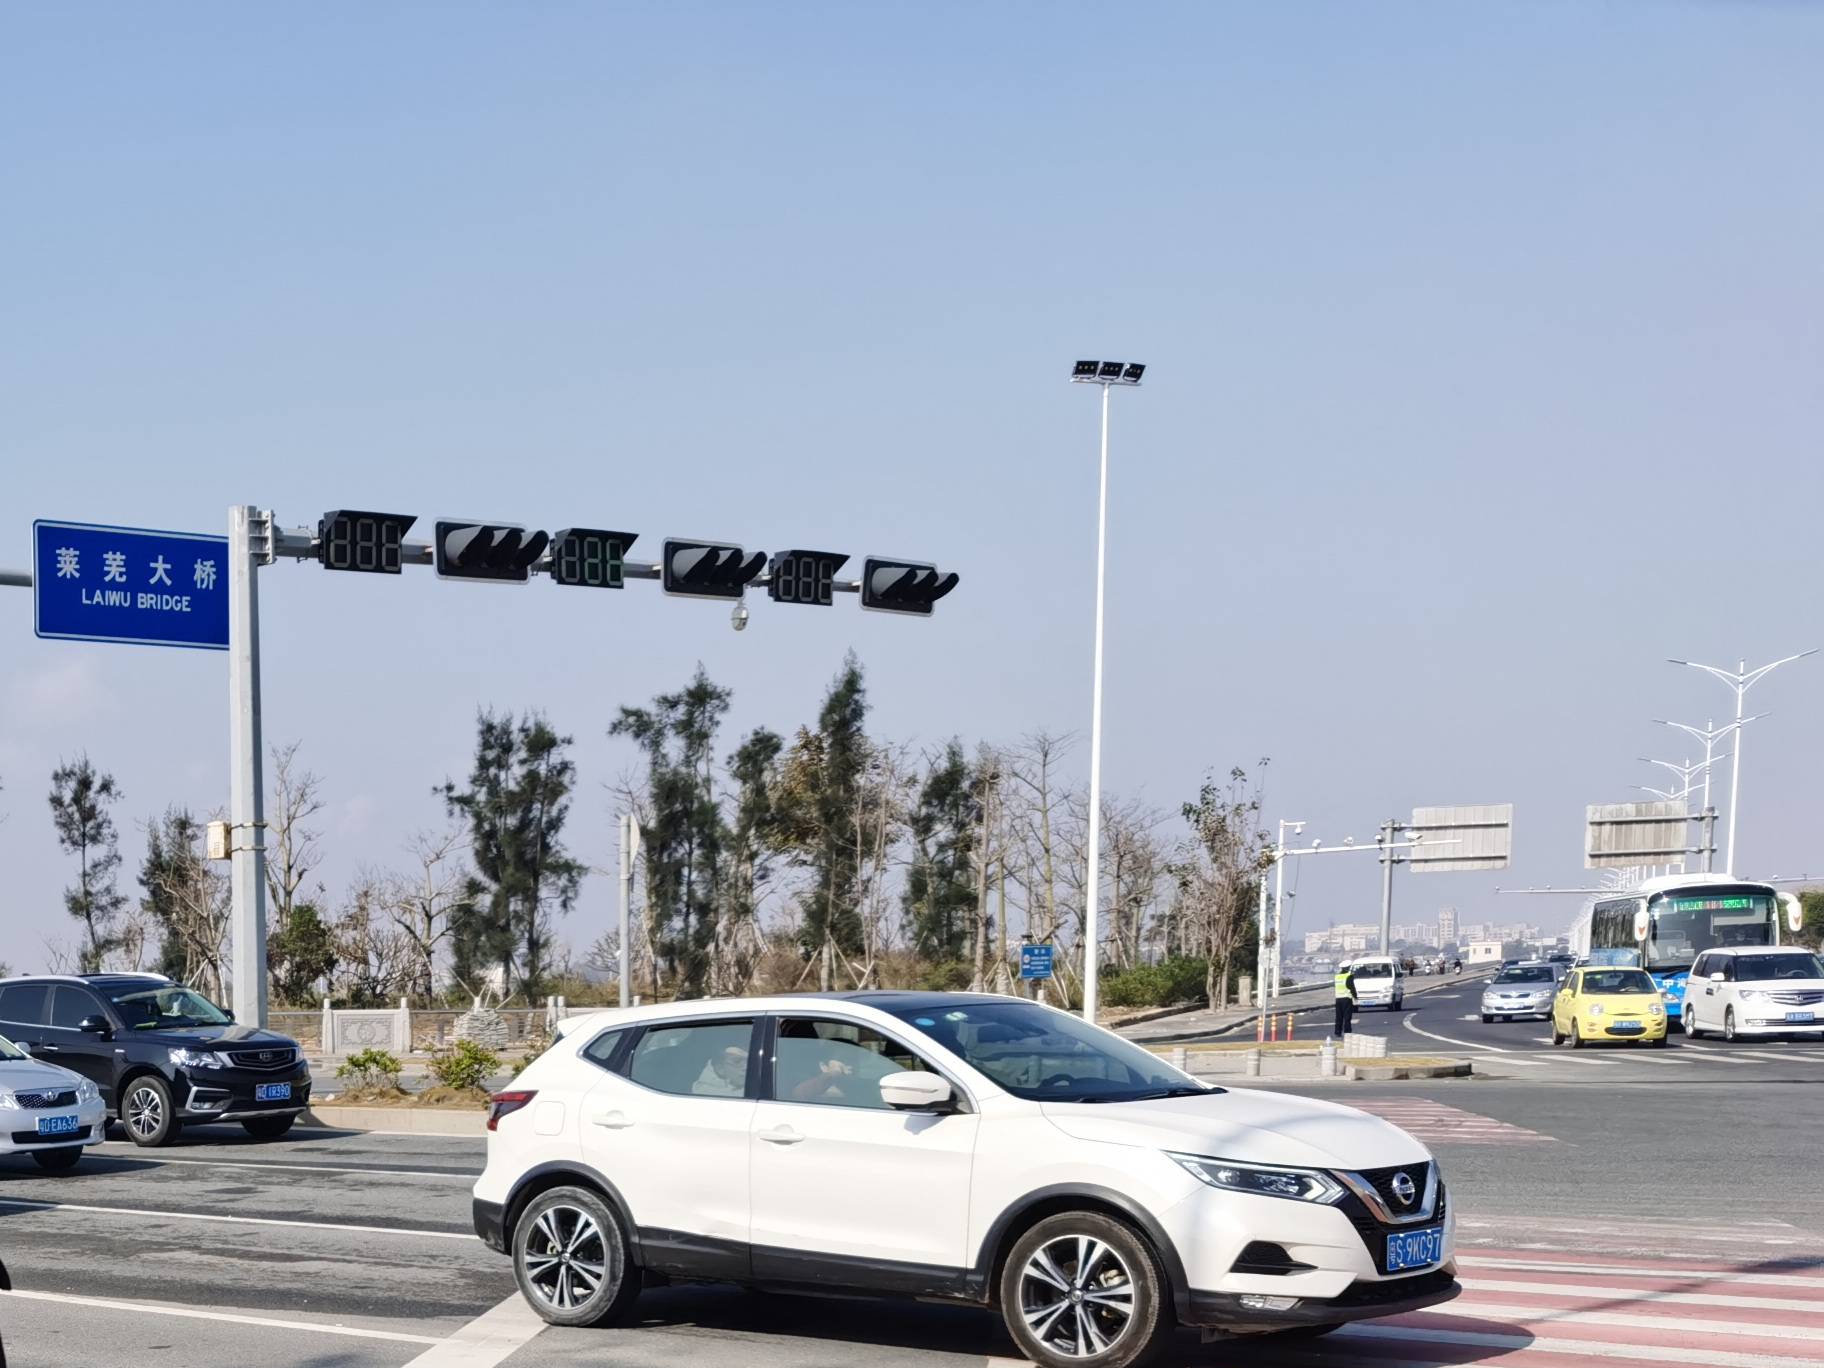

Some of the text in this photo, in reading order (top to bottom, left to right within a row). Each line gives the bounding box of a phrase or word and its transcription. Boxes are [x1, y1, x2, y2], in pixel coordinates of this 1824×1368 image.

[56, 547, 217, 590] 莱芜大桥
[82, 588, 192, 612] LAIWU BRIDGE
